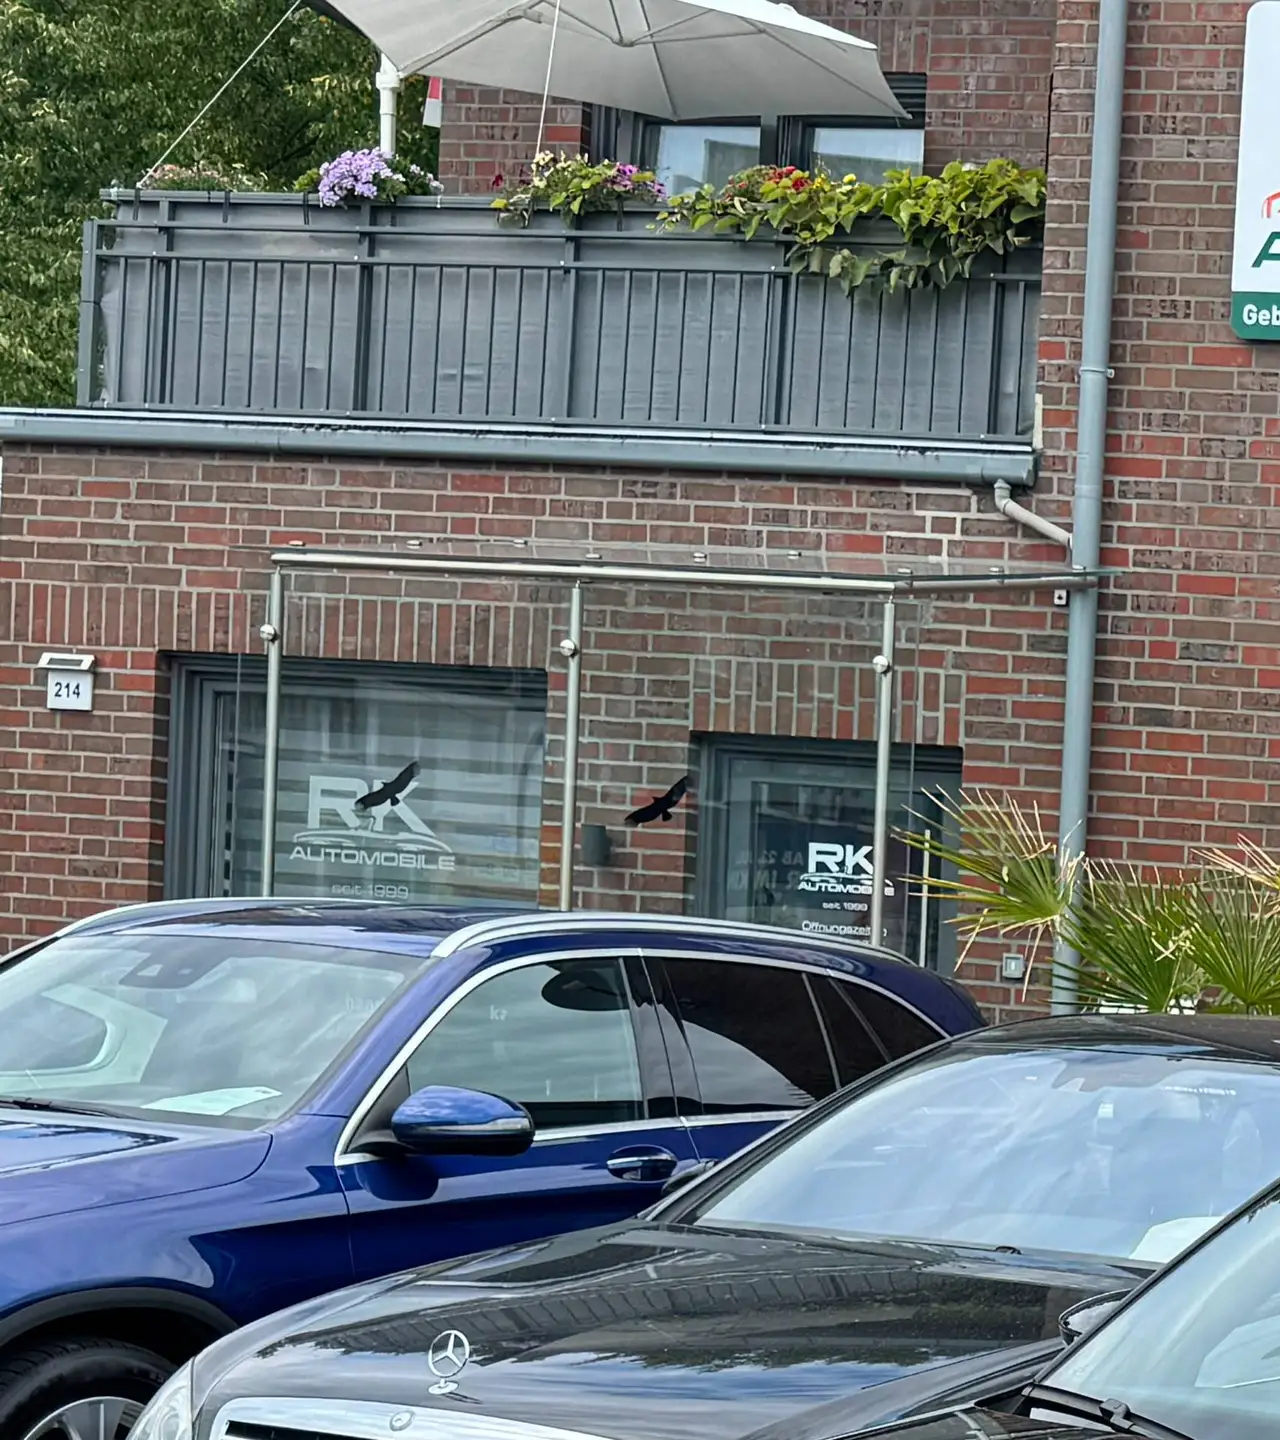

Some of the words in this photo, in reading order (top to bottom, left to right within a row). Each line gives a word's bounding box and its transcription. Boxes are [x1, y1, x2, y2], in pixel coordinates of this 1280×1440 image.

[54, 681, 81, 699] 214
[307, 775, 436, 837] RK
[289, 846, 456, 871] AUTOMOBILE
[808, 842, 874, 875] RK
[368, 884, 409, 899] 1999
[798, 881, 895, 896] AUTOMOBE
